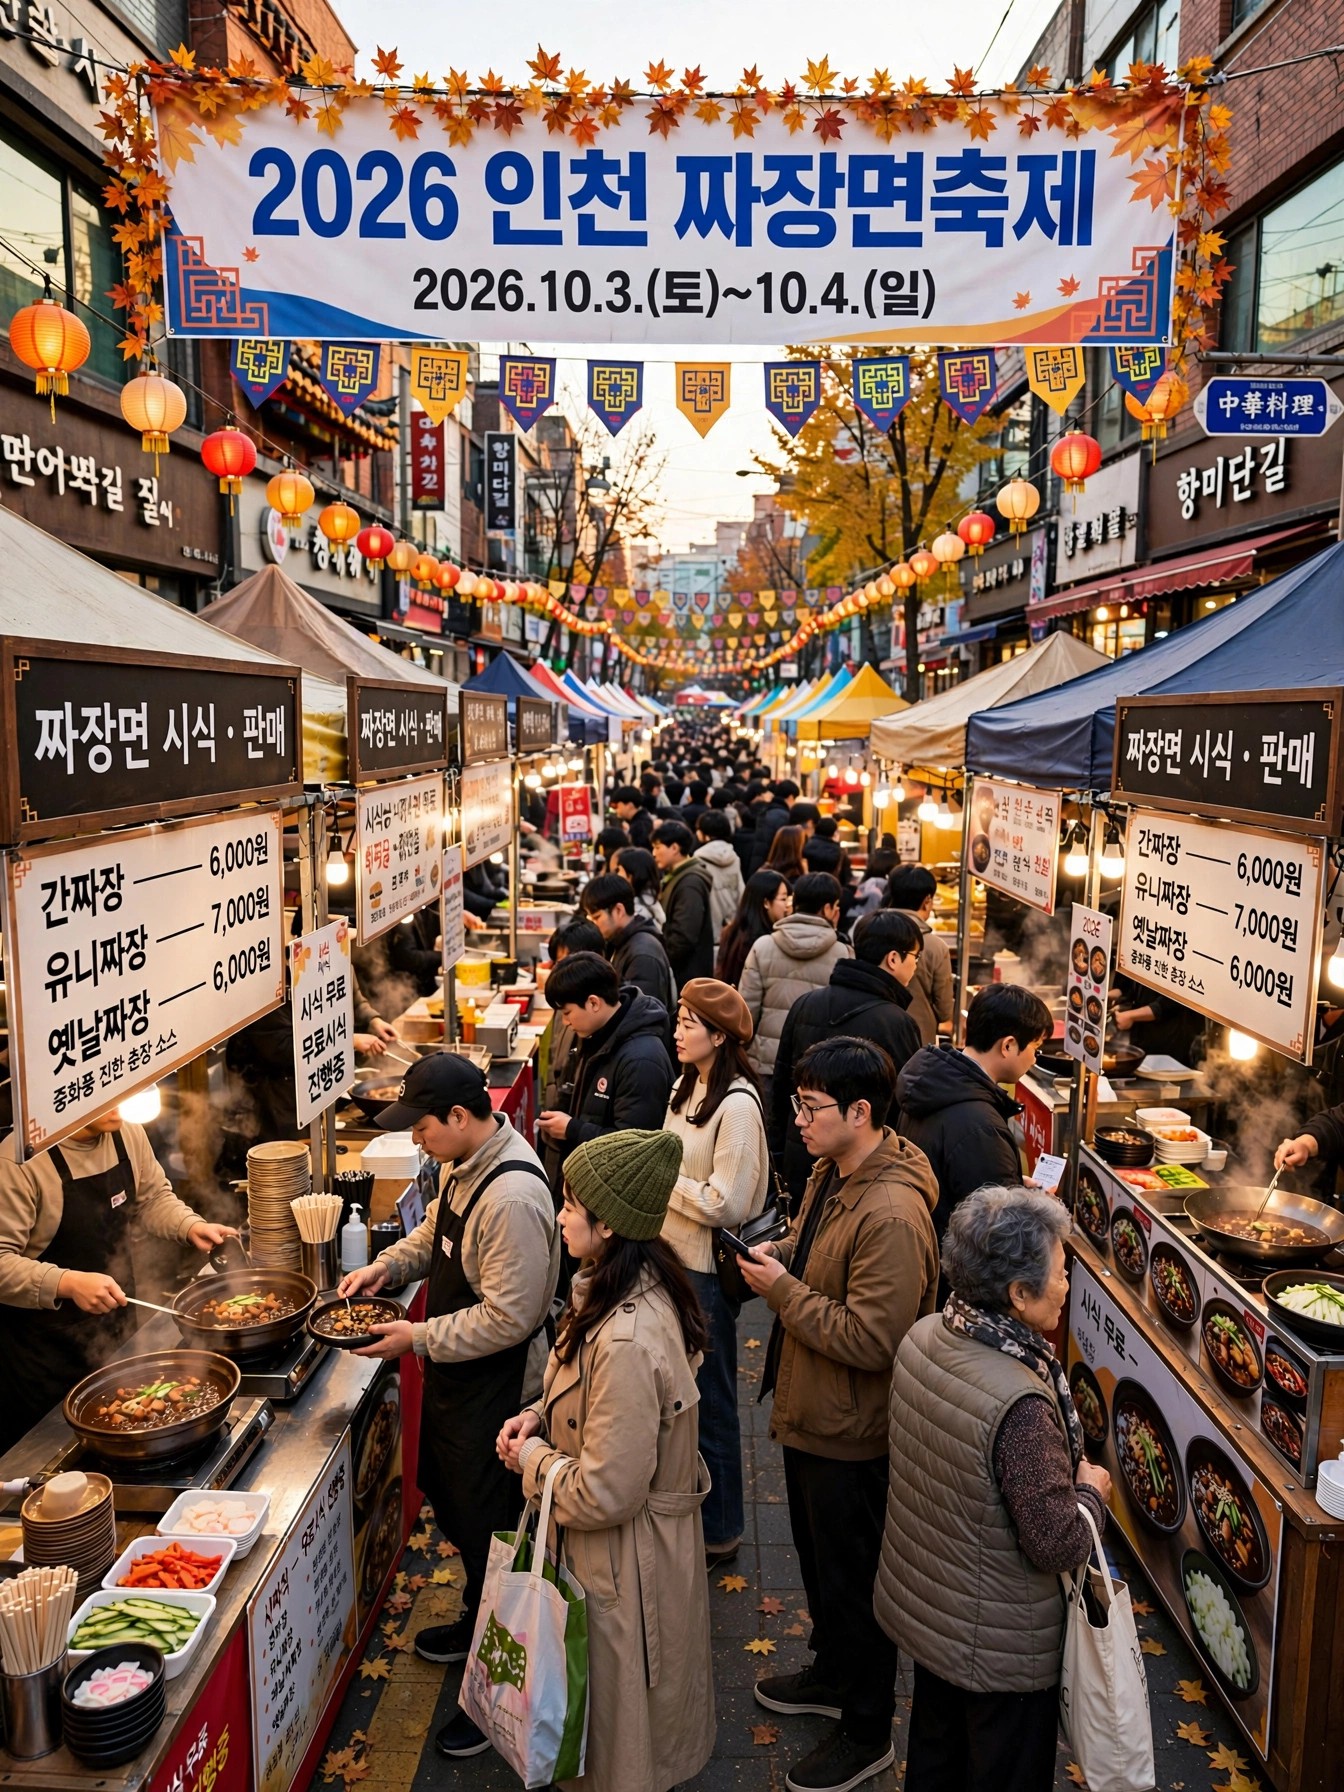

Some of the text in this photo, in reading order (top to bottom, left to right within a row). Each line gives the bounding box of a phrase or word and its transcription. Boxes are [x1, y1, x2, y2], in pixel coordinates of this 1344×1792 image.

[248, 146, 1096, 248] 2026 인천 짜장면축제
[412, 266, 937, 319] 2026.10.3.(토)~10.4.(일)
[1218, 390, 1314, 420] 中華料理
[1176, 437, 1286, 520] 항미단길
[34, 701, 150, 775] 짜장면
[162, 702, 216, 765] 시식
[243, 704, 285, 760] 판매
[360, 707, 396, 749] 짜장면
[399, 708, 418, 746] 시식
[1126, 728, 1183, 775] 짜장면
[1189, 729, 1234, 781] 시식
[1260, 731, 1316, 789] 판매
[40, 831, 269, 930] 간짜장 6,000원
[1138, 828, 1304, 897] 간짜장 6,000원
[44, 884, 270, 1003] 유니짜장 7,000원
[1134, 871, 1299, 953] 유니짜장 7,000원
[300, 974, 347, 1022] 시식 무료
[1132, 914, 1294, 1009] 옛날짜장 6,000원
[47, 989, 151, 1076] 옛날짜장
[213, 936, 271, 994] 6,000원
[302, 1012, 347, 1065] 무료시식
[53, 1028, 178, 1114] 중화풍 진한 춘장 소스
[307, 1050, 346, 1104] 진행중
[1081, 1288, 1101, 1333] 시식
[1104, 1313, 1126, 1361] 무료
